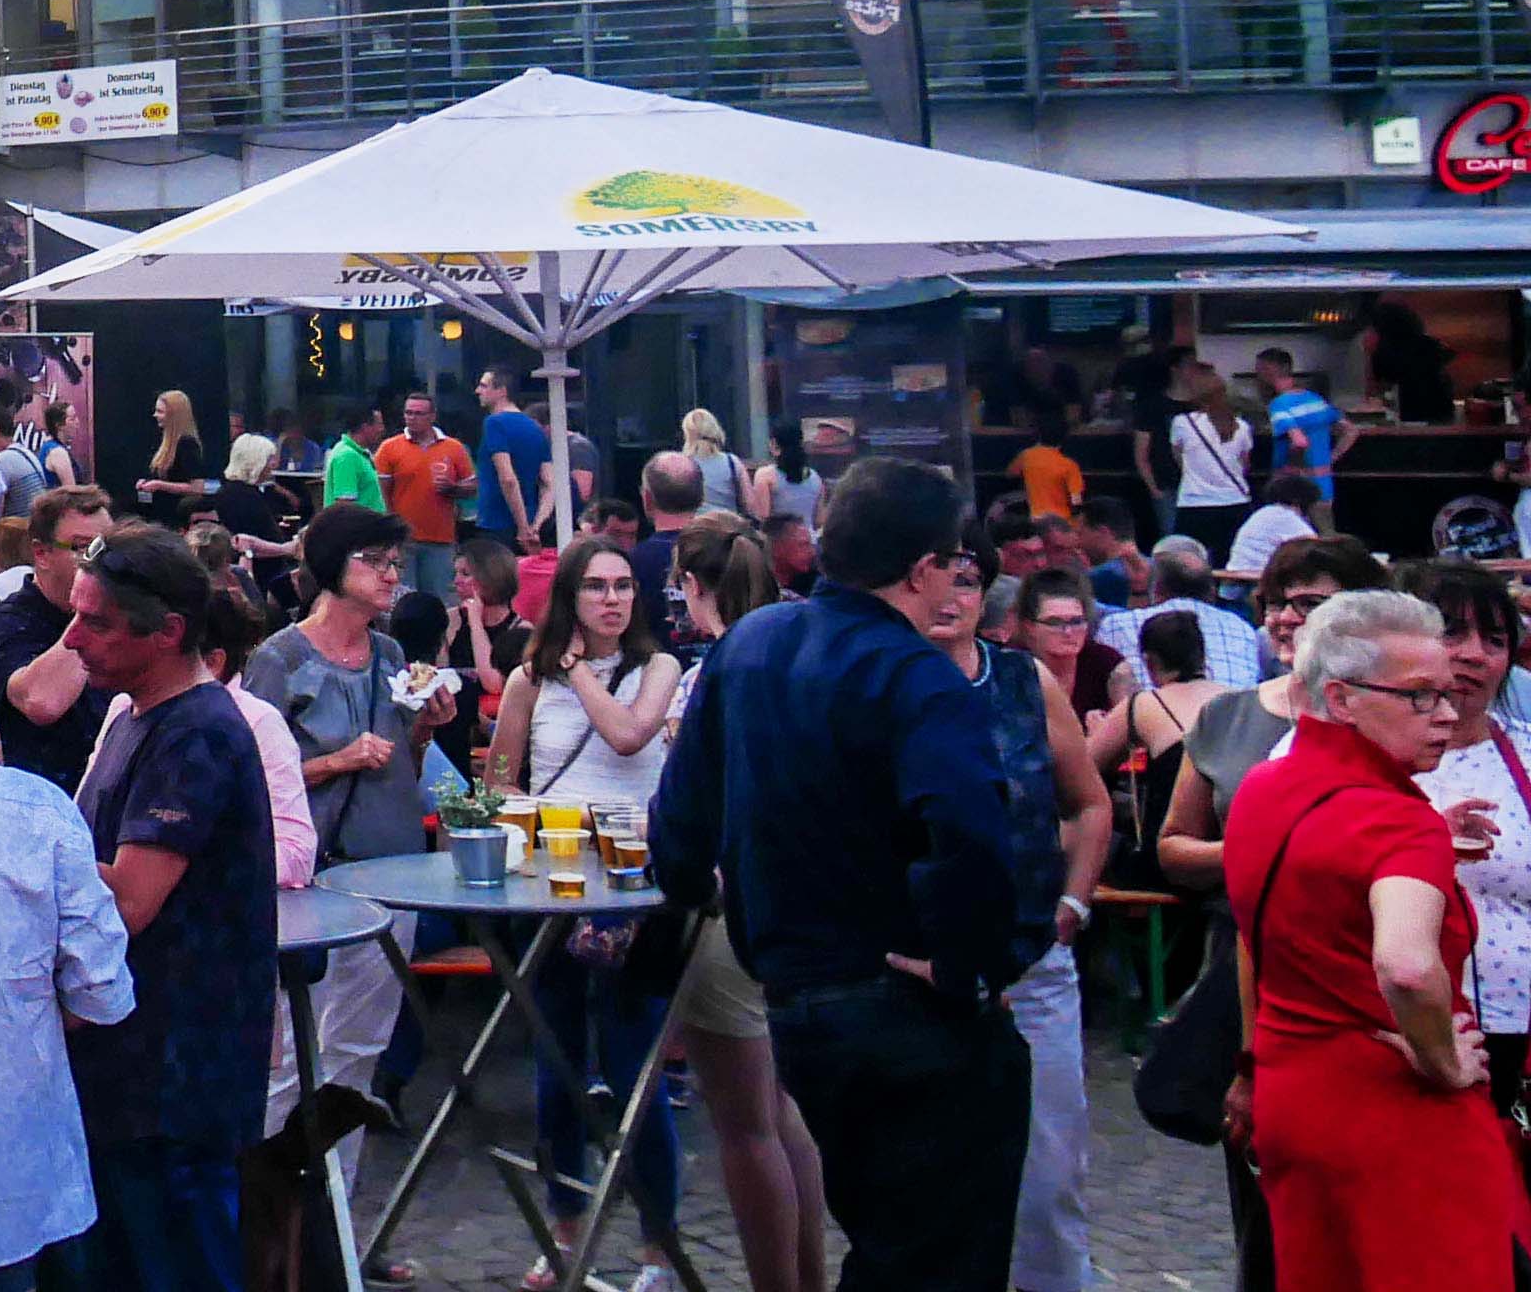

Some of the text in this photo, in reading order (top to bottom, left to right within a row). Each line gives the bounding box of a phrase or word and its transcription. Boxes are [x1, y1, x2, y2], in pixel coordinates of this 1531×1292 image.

[107, 71, 156, 83] Donnerstag
[10, 81, 46, 92] Dienstag
[17, 94, 52, 106] Pizzatag
[575, 216, 819, 238] SOMERSBY
